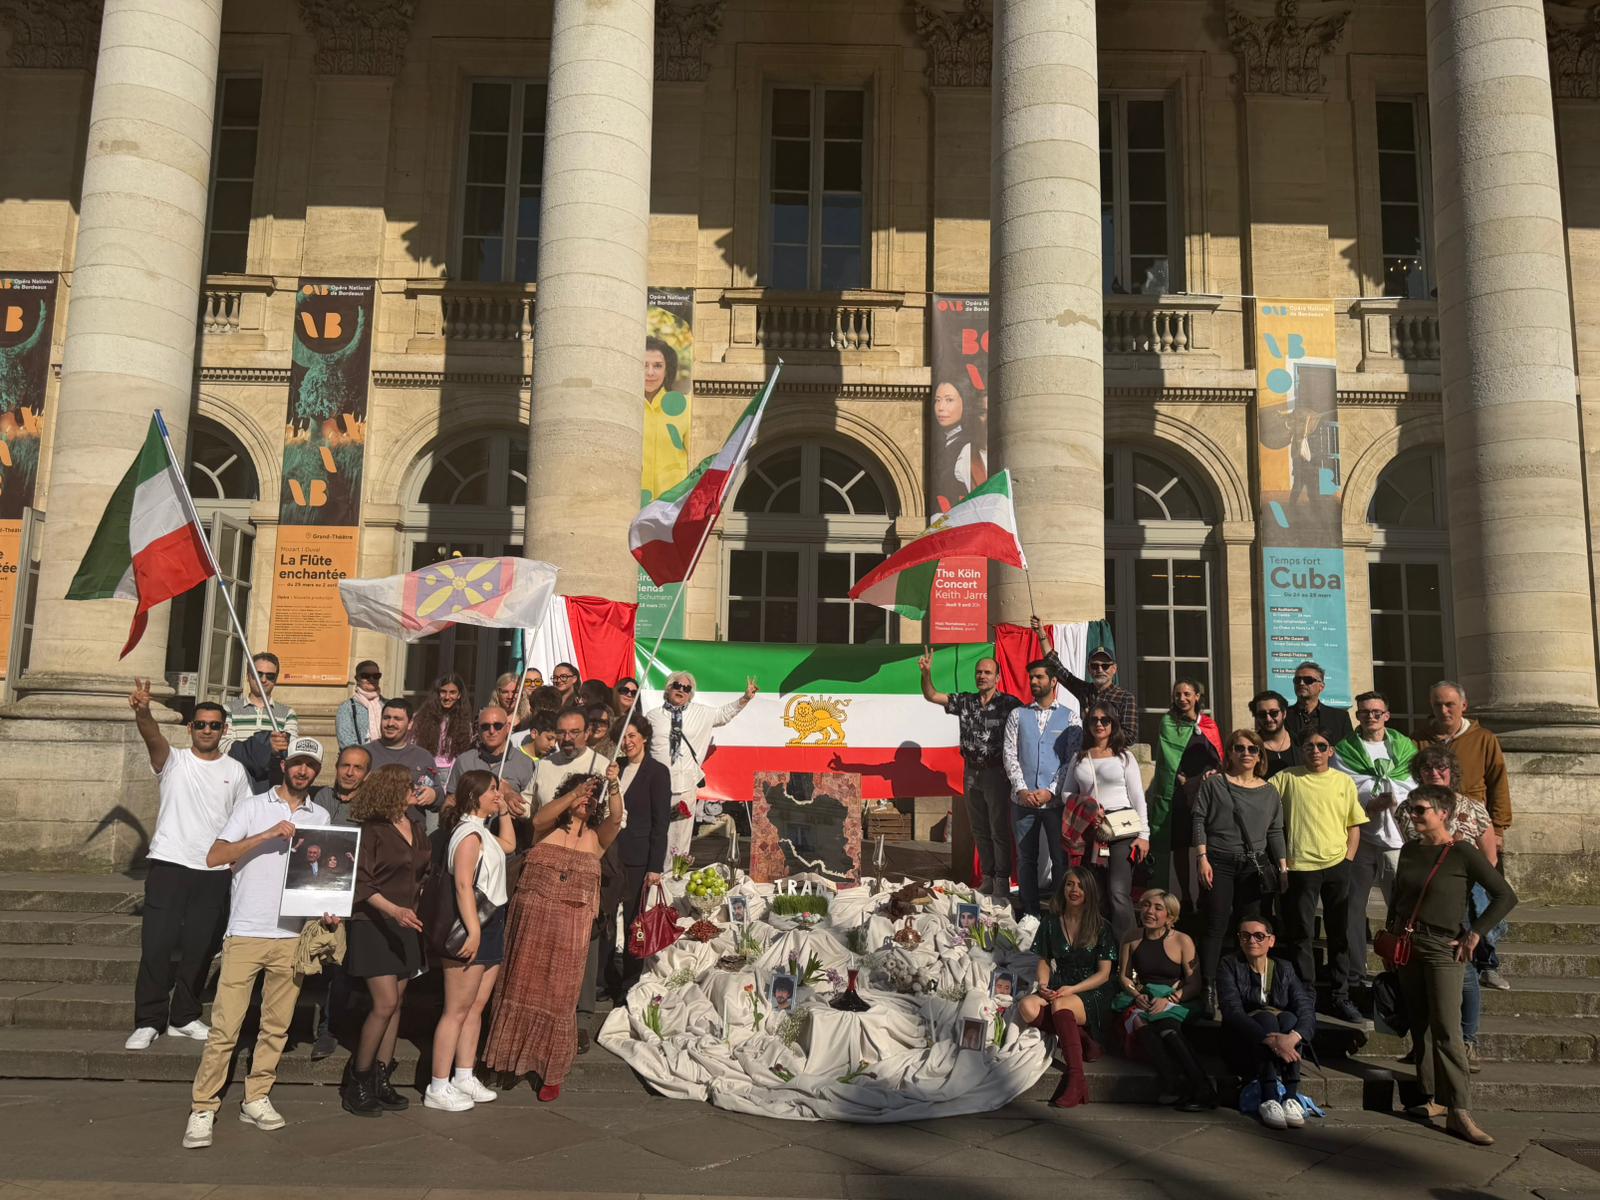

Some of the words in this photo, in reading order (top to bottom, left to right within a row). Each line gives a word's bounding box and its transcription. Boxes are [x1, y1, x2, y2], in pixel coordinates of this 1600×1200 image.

[280, 553, 296, 566] La
[299, 554, 333, 567] Flûte
[1269, 556, 1300, 566] Temps
[1303, 557, 1321, 565] fort
[279, 568, 347, 580] enchantée
[936, 569, 955, 578] The
[958, 569, 981, 579] Köln
[1270, 566, 1342, 590] Cuba
[935, 579, 978, 589] Concert
[935, 590, 961, 599] Keith
[774, 879, 828, 897] IRAN
